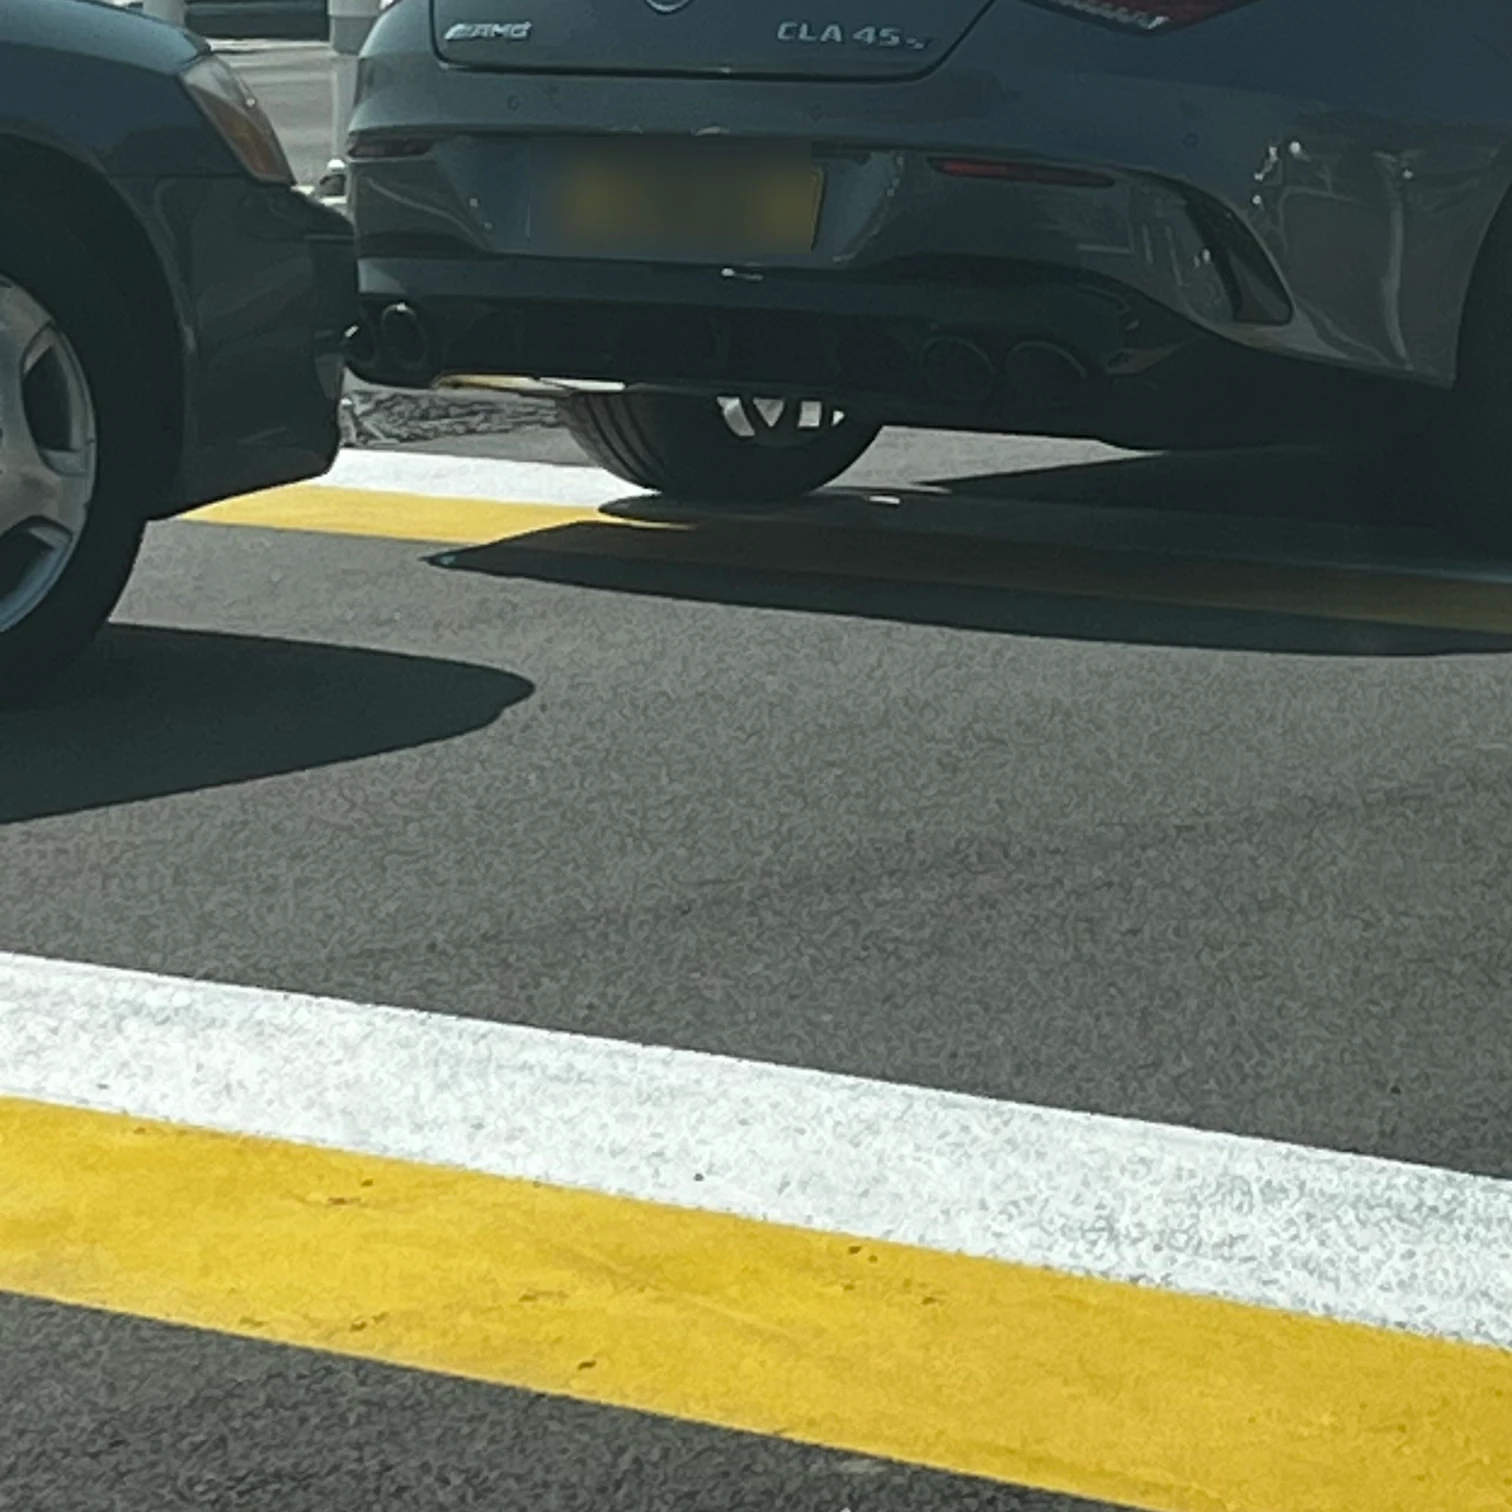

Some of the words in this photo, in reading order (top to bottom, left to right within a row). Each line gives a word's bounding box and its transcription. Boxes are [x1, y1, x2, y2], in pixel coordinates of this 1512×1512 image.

[464, 21, 532, 39] AMG
[776, 21, 843, 42] CLA
[852, 26, 901, 47] 45
